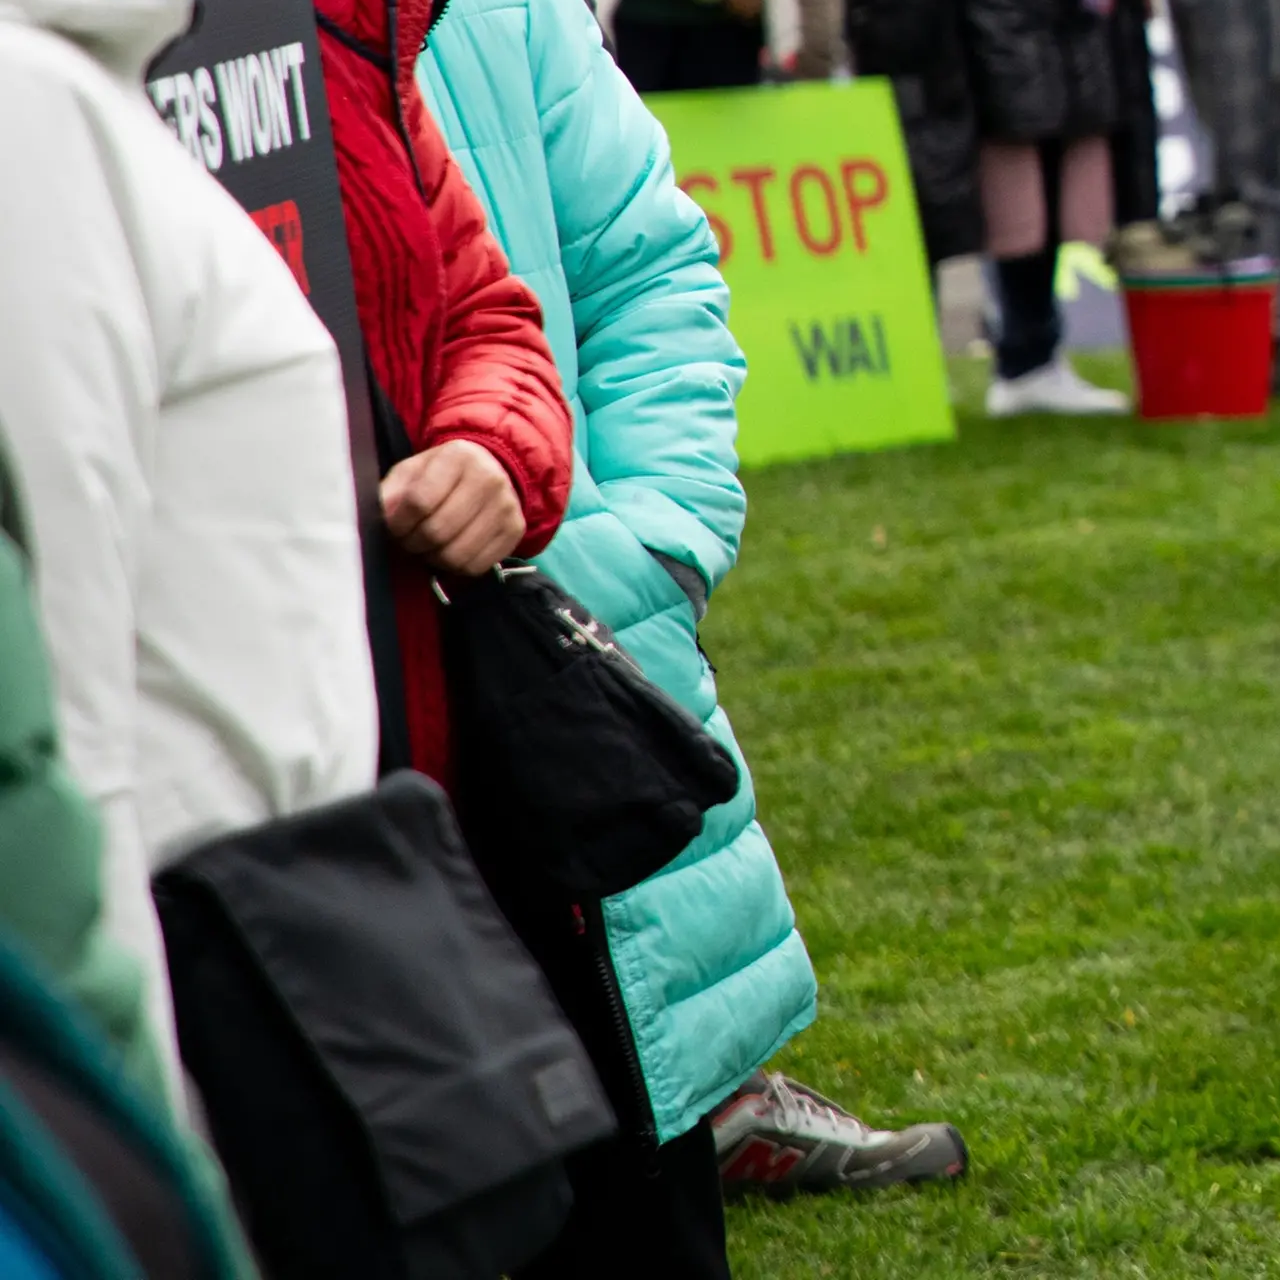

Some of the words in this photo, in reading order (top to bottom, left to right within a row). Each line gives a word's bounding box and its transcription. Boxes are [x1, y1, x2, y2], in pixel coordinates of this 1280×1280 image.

[214, 42, 311, 162] WON'T
[678, 156, 889, 268] STOP
[788, 313, 892, 381] WAI
